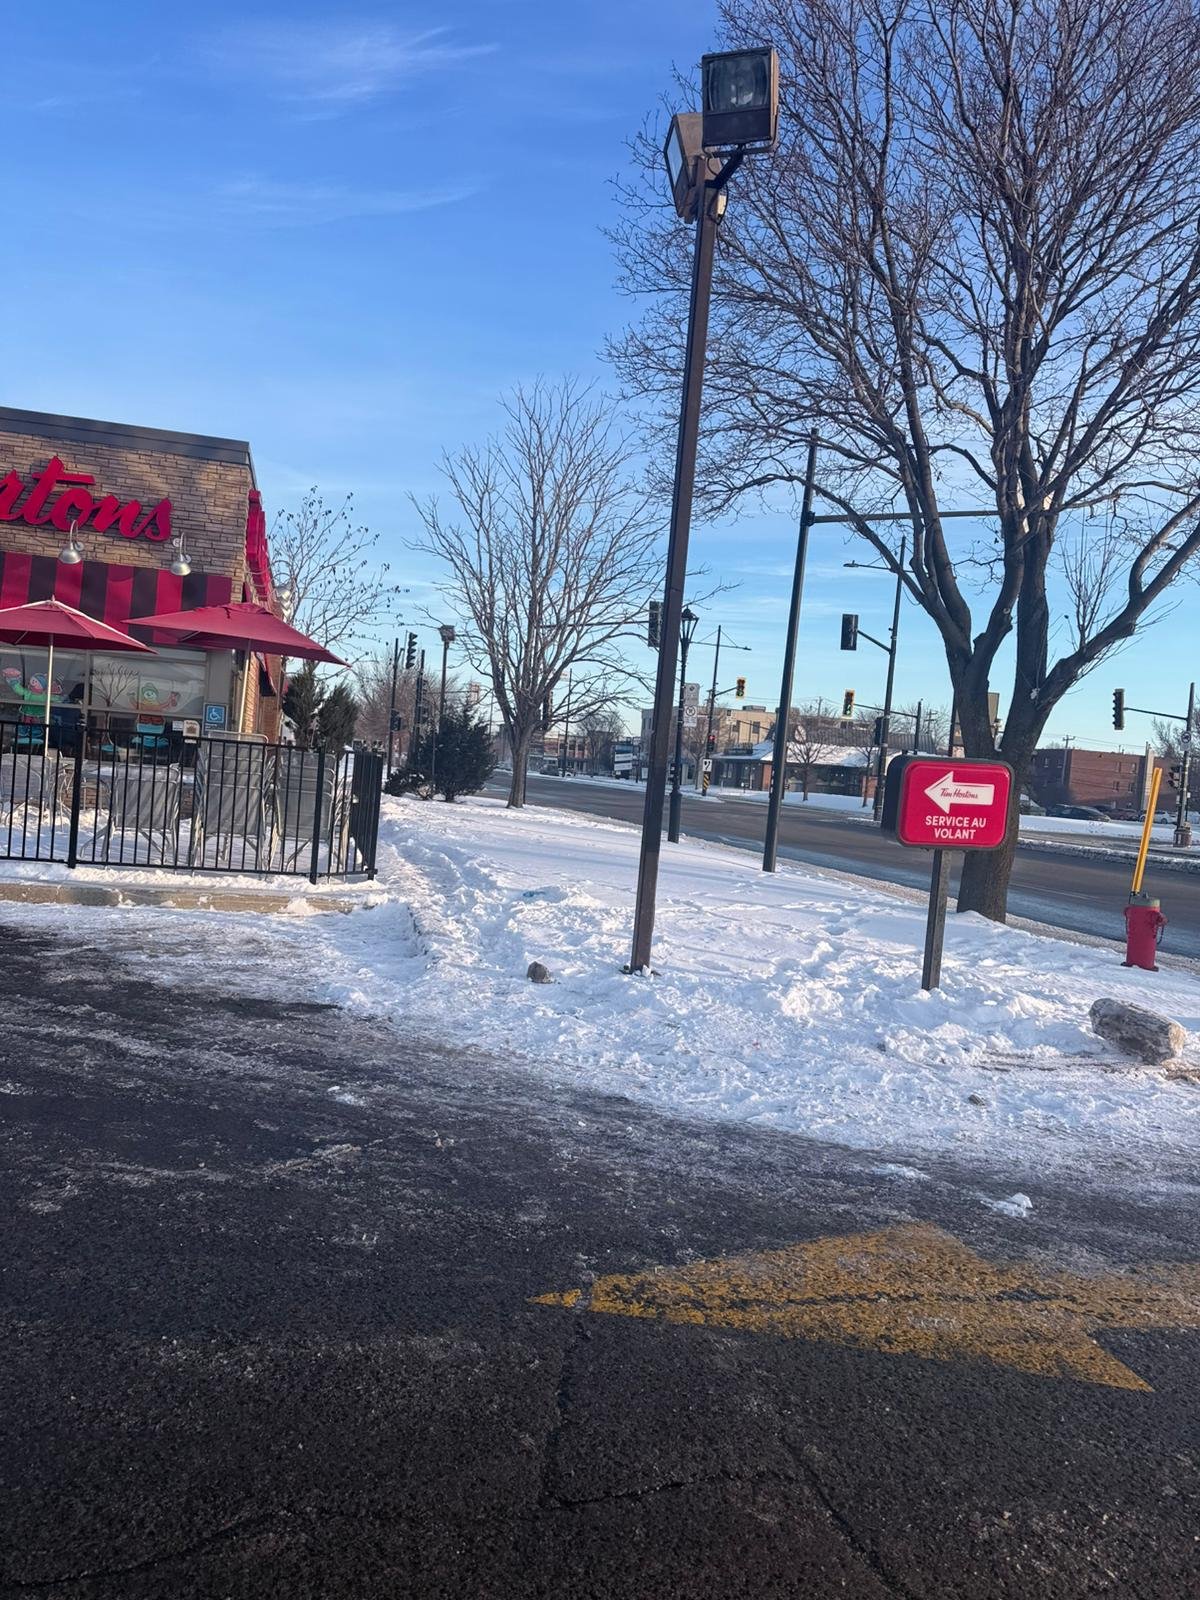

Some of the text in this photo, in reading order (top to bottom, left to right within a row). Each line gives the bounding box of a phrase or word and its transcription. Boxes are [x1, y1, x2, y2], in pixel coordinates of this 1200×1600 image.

[940, 787, 978, 799] Tim Hortons
[925, 815, 987, 828] SERVICE AU
[934, 828, 976, 840] VOLANT
